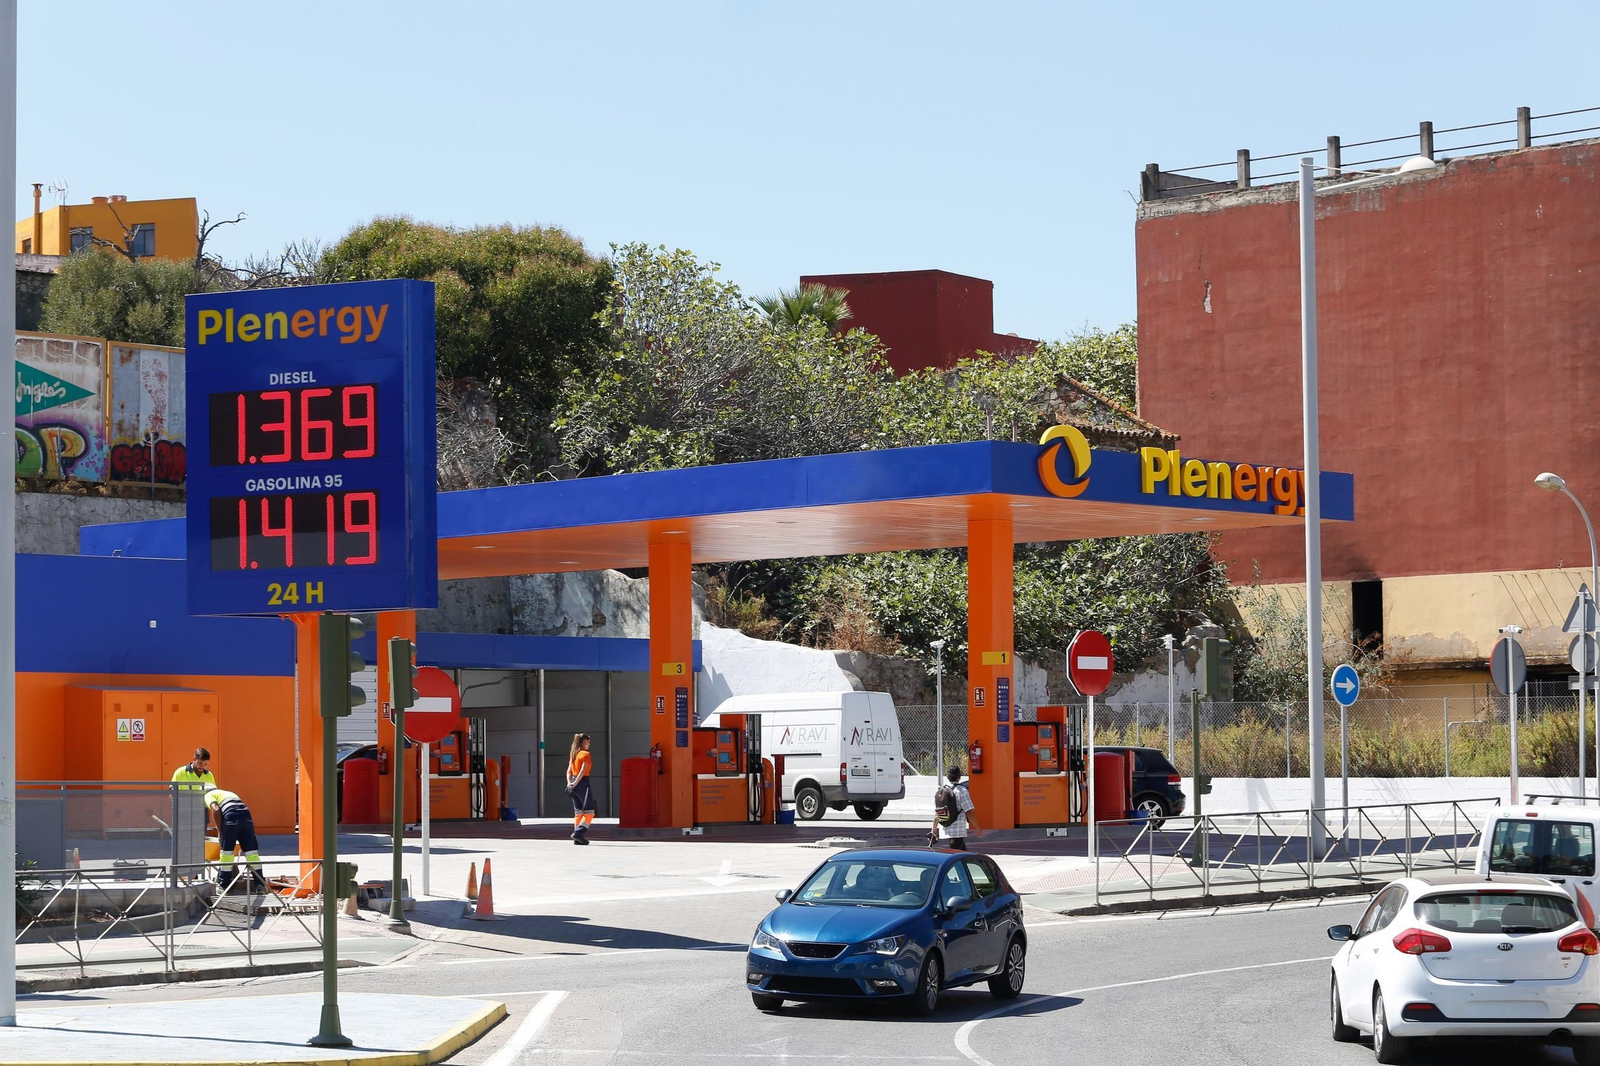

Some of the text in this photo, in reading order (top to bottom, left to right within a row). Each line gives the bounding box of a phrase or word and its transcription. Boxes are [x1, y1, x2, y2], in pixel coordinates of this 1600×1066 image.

[198, 304, 389, 345] Plenergy
[269, 371, 317, 386] DIESEL
[237, 385, 375, 465] 1.369
[245, 474, 343, 491] GASOLINA 95
[239, 492, 377, 570] 1.419
[267, 581, 324, 605] 24 H
[1001, 653, 1006, 663] 1
[676, 664, 682, 673] 3
[798, 727, 828, 741] RAVI
[866, 727, 893, 741] RAVI
